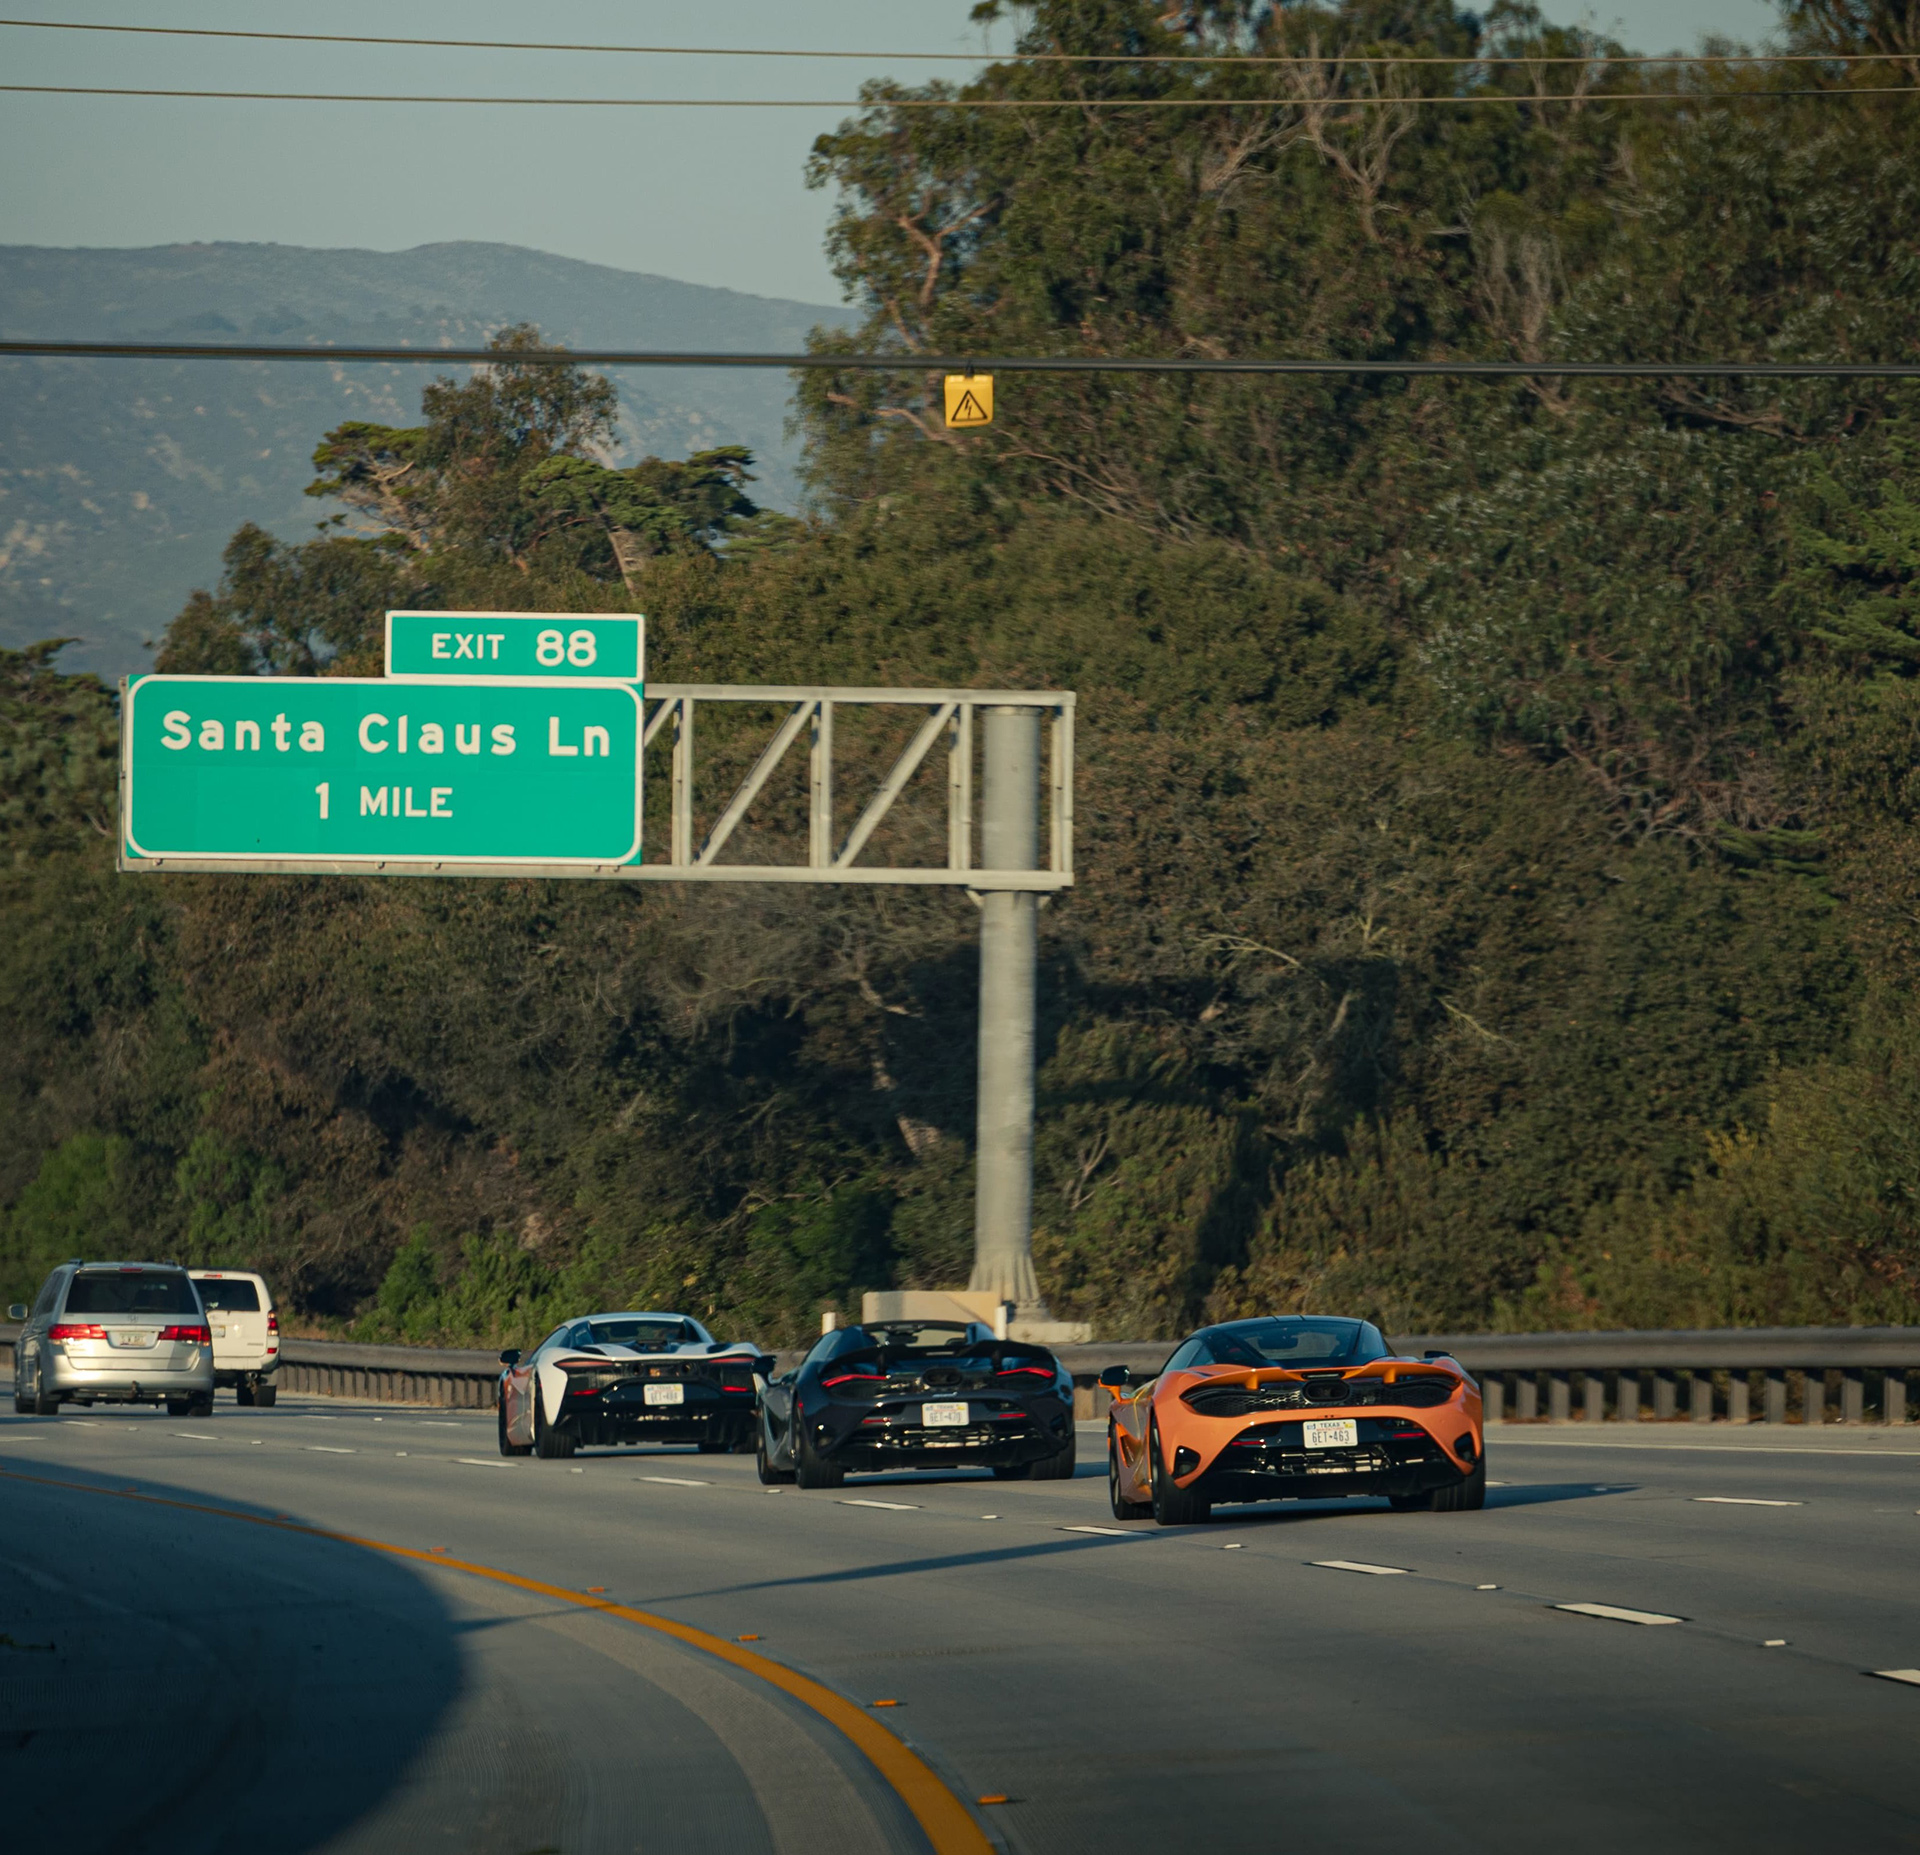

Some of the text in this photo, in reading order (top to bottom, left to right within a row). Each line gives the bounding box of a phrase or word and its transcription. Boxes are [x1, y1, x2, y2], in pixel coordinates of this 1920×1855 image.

[431, 629, 598, 668] EXIT 88
[160, 710, 611, 759] Santa Claus Ln
[315, 782, 455, 821] 1 MILE
